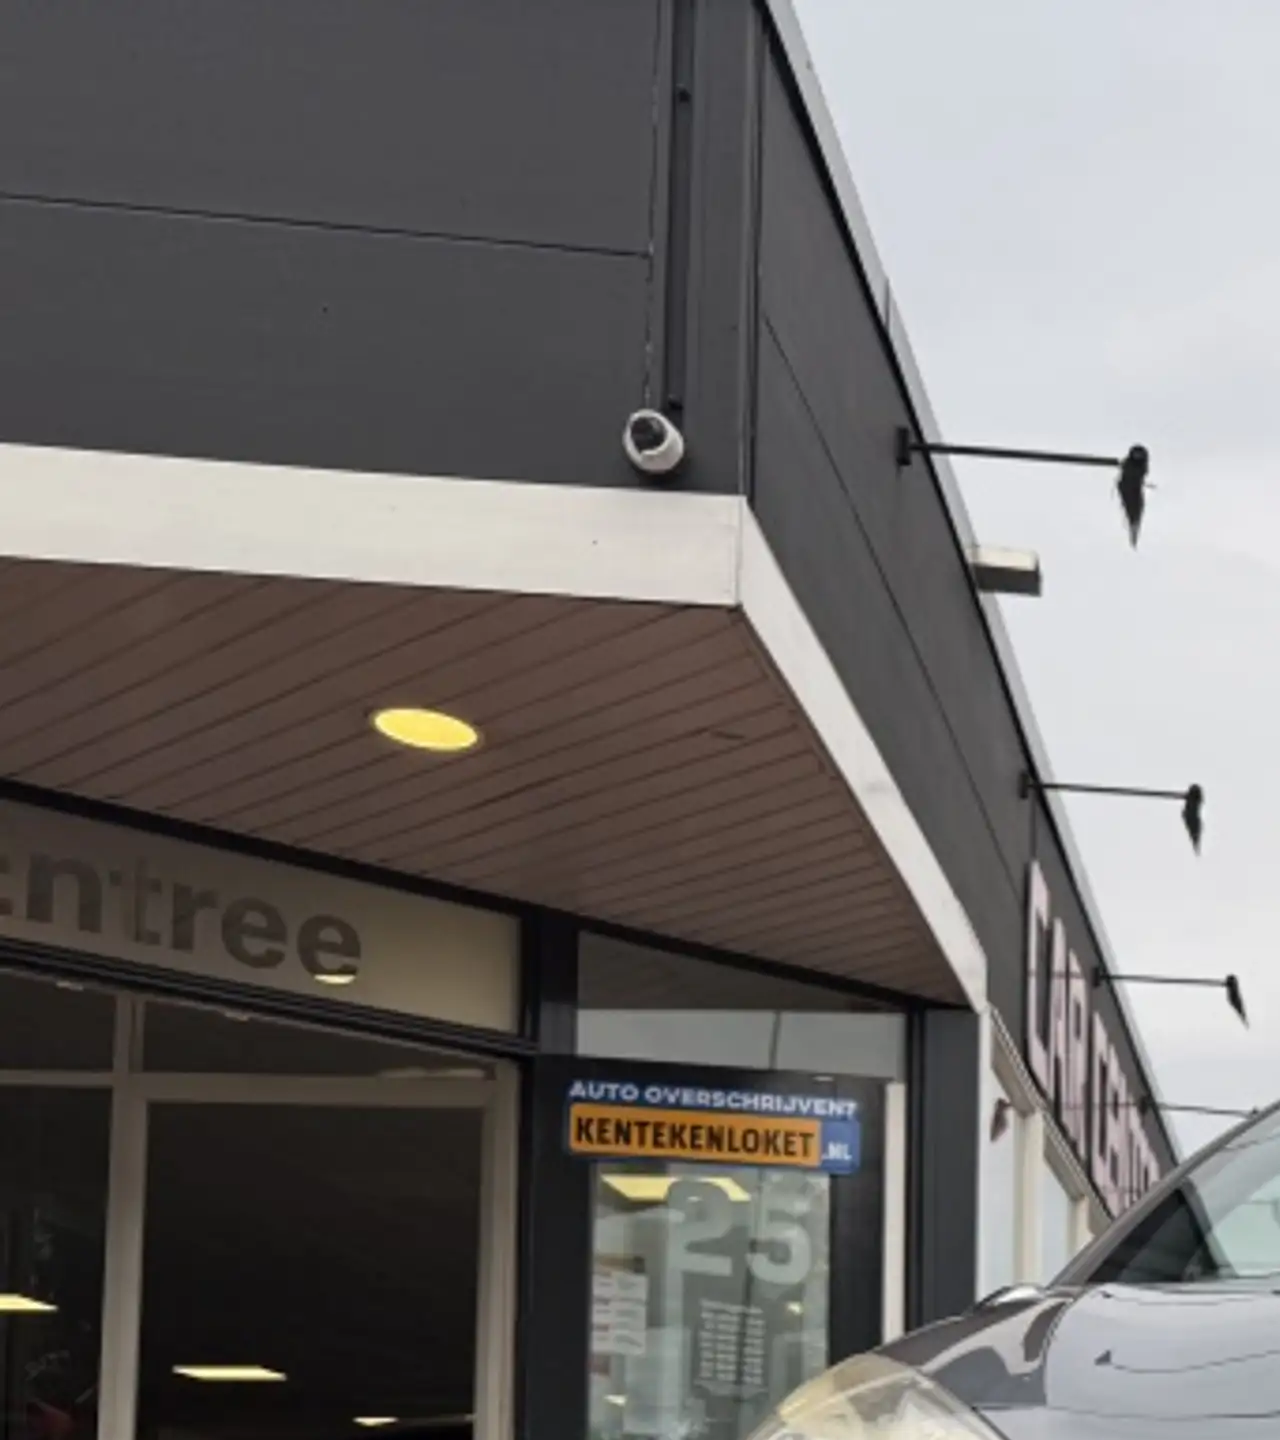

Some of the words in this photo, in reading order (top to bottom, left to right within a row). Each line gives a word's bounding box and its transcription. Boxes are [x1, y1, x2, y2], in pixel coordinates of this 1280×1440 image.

[0, 853, 362, 986] ntree
[569, 1080, 638, 1101] AUTO
[576, 1115, 815, 1159] KENTEKENLOKET
